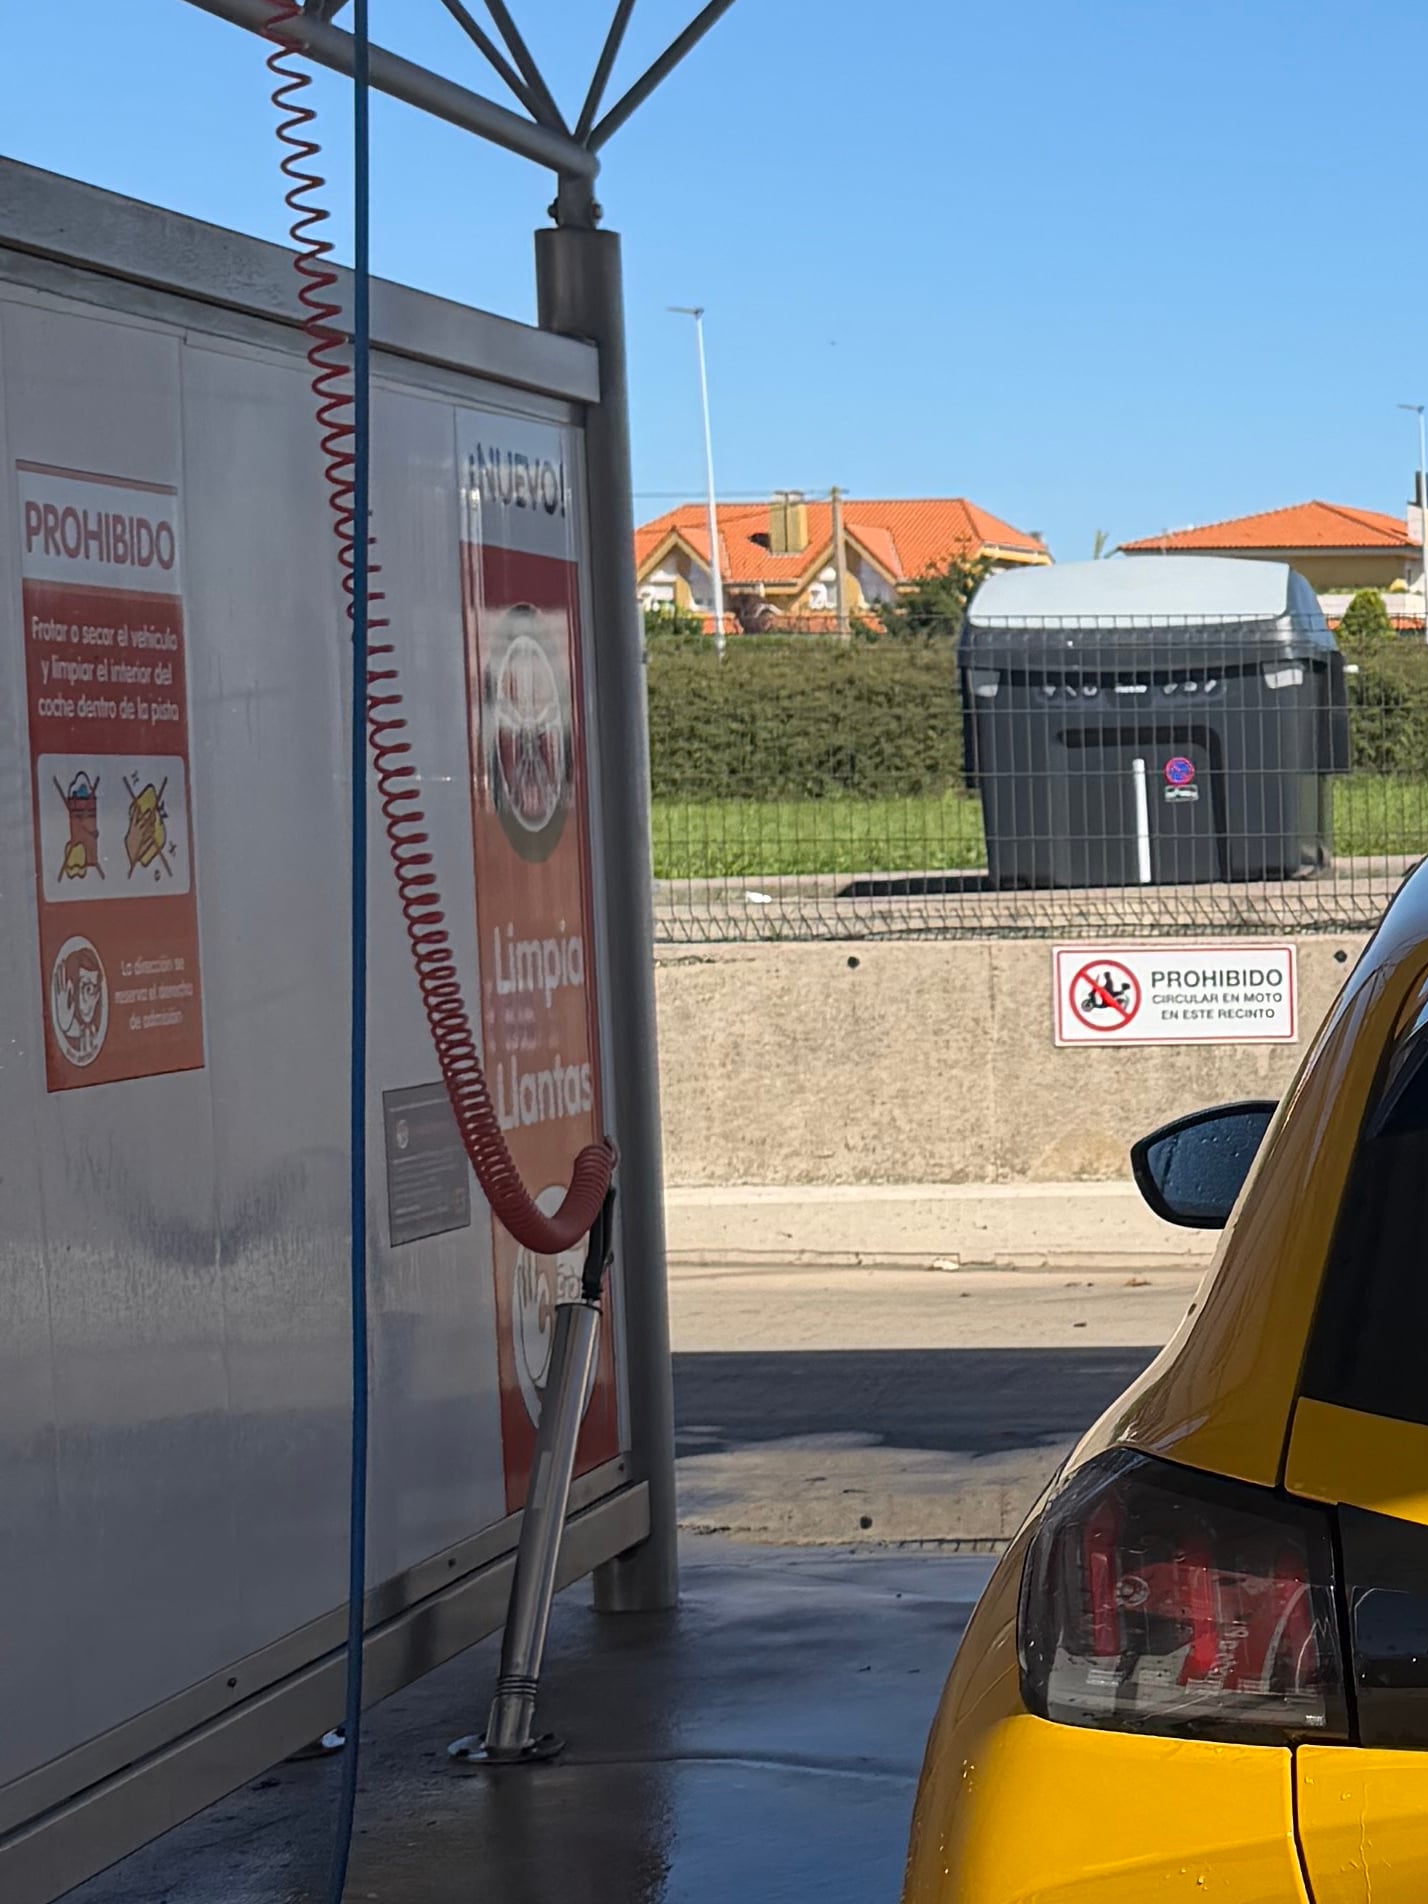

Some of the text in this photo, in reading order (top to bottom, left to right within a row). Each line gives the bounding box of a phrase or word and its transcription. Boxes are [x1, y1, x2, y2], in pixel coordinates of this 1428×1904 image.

[25, 500, 176, 570] PROHIBIDO
[32, 615, 67, 642] Frotar
[70, 625, 79, 643] o
[82, 625, 114, 645] secar
[117, 624, 128, 646] el
[41, 654, 172, 686] y limpiar el interior del
[38, 692, 179, 726] coche dentro de la pista
[494, 918, 584, 1008] Limpia
[1151, 969, 1283, 988] PROHIBIDO
[1152, 992, 1282, 1004] CIRCULAR EN MOTO
[1161, 1008, 1275, 1020] EN ESTE RECINTO
[497, 1054, 593, 1130] Llantas
